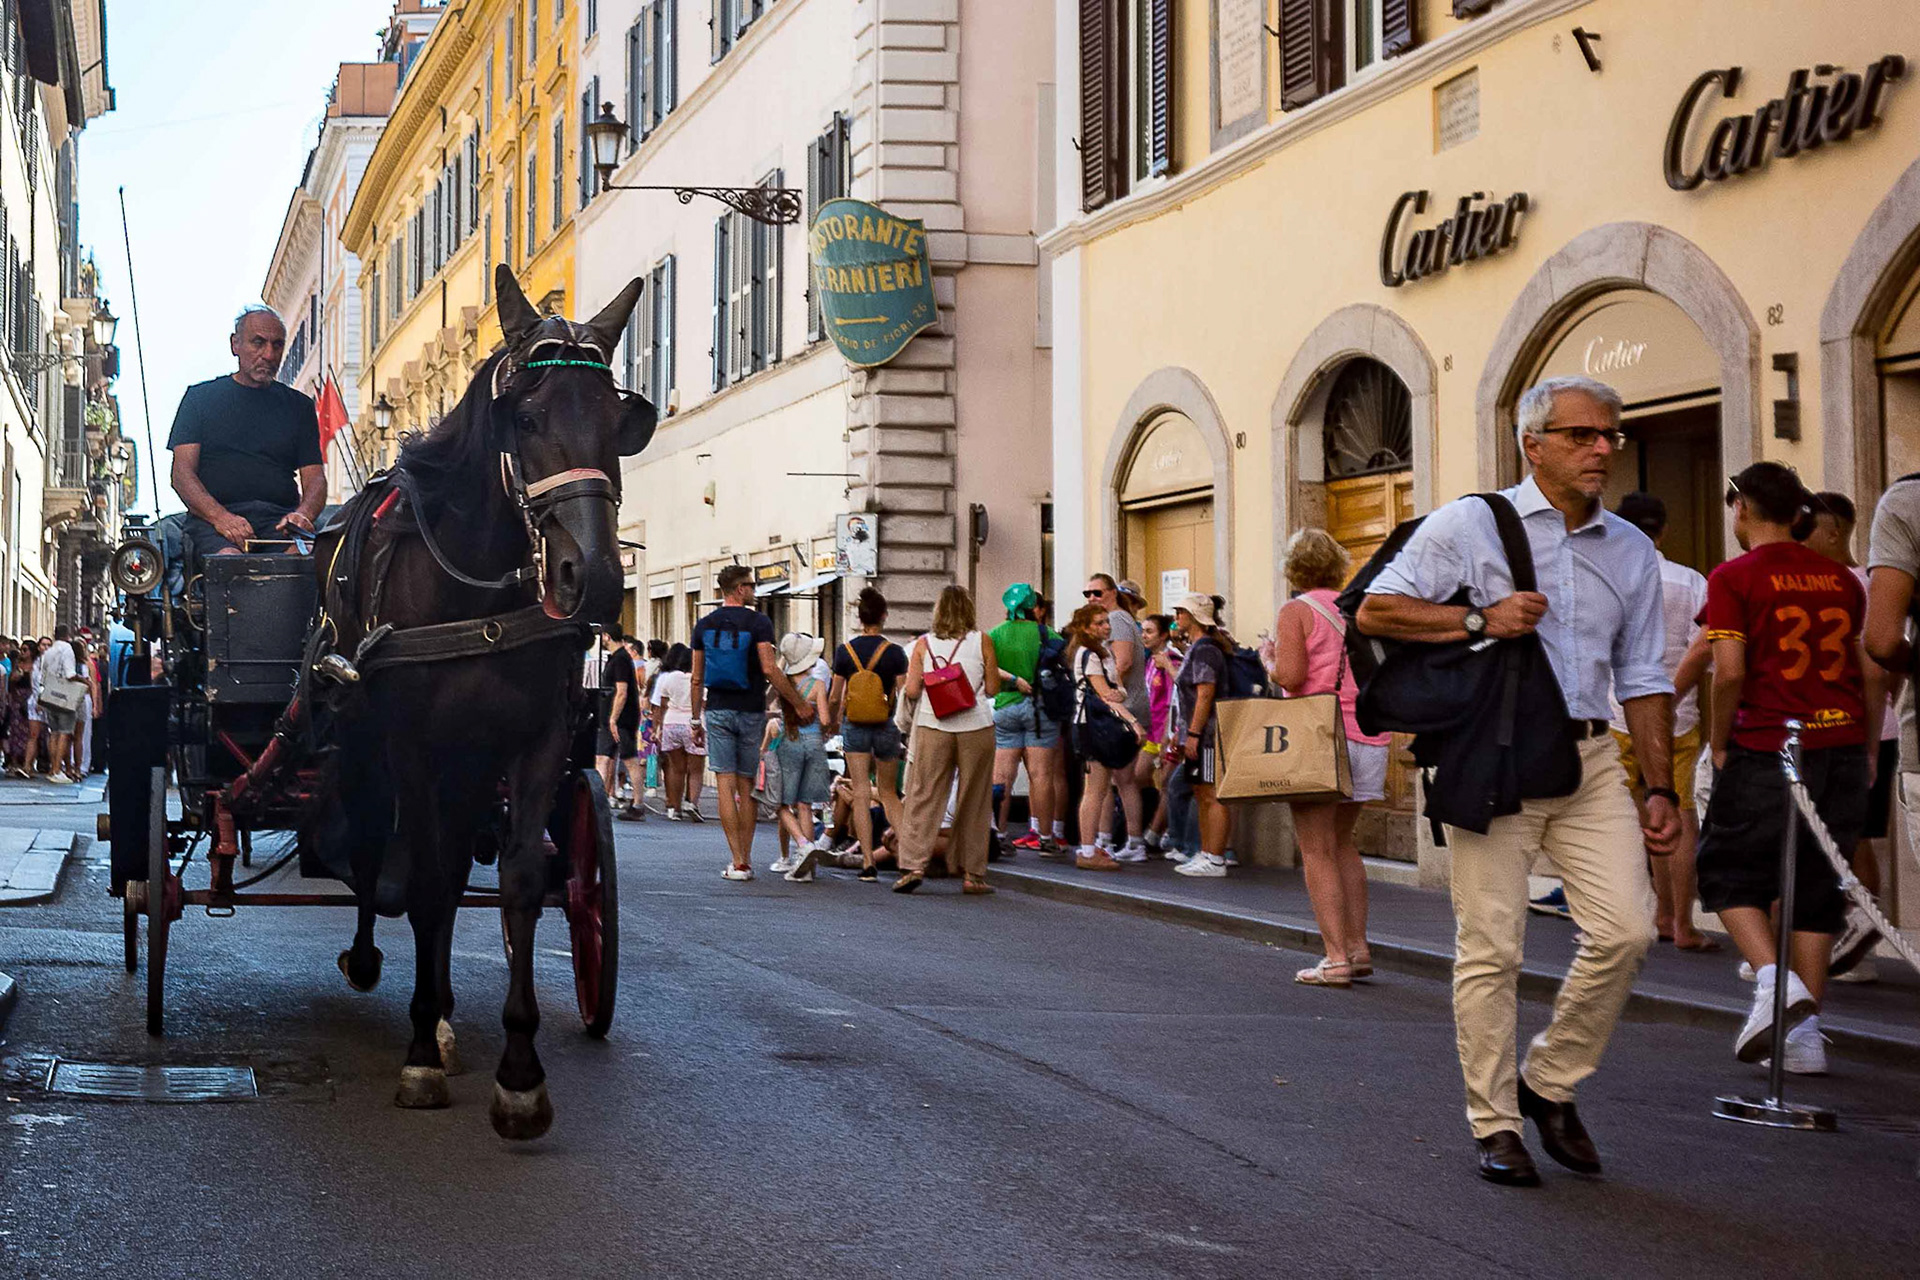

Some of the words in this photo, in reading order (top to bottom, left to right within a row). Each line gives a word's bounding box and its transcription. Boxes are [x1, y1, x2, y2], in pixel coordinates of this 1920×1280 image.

[1663, 53, 1907, 191] Cartier
[1380, 189, 1529, 288] Cartier
[1767, 303, 1785, 326] 82
[883, 319, 914, 344] FIORI
[1584, 336, 1648, 375] Cartier
[1236, 431, 1247, 449] 80
[1770, 574, 1844, 592] KALINIC
[1775, 605, 1851, 681] 33
[1263, 725, 1290, 754] B
